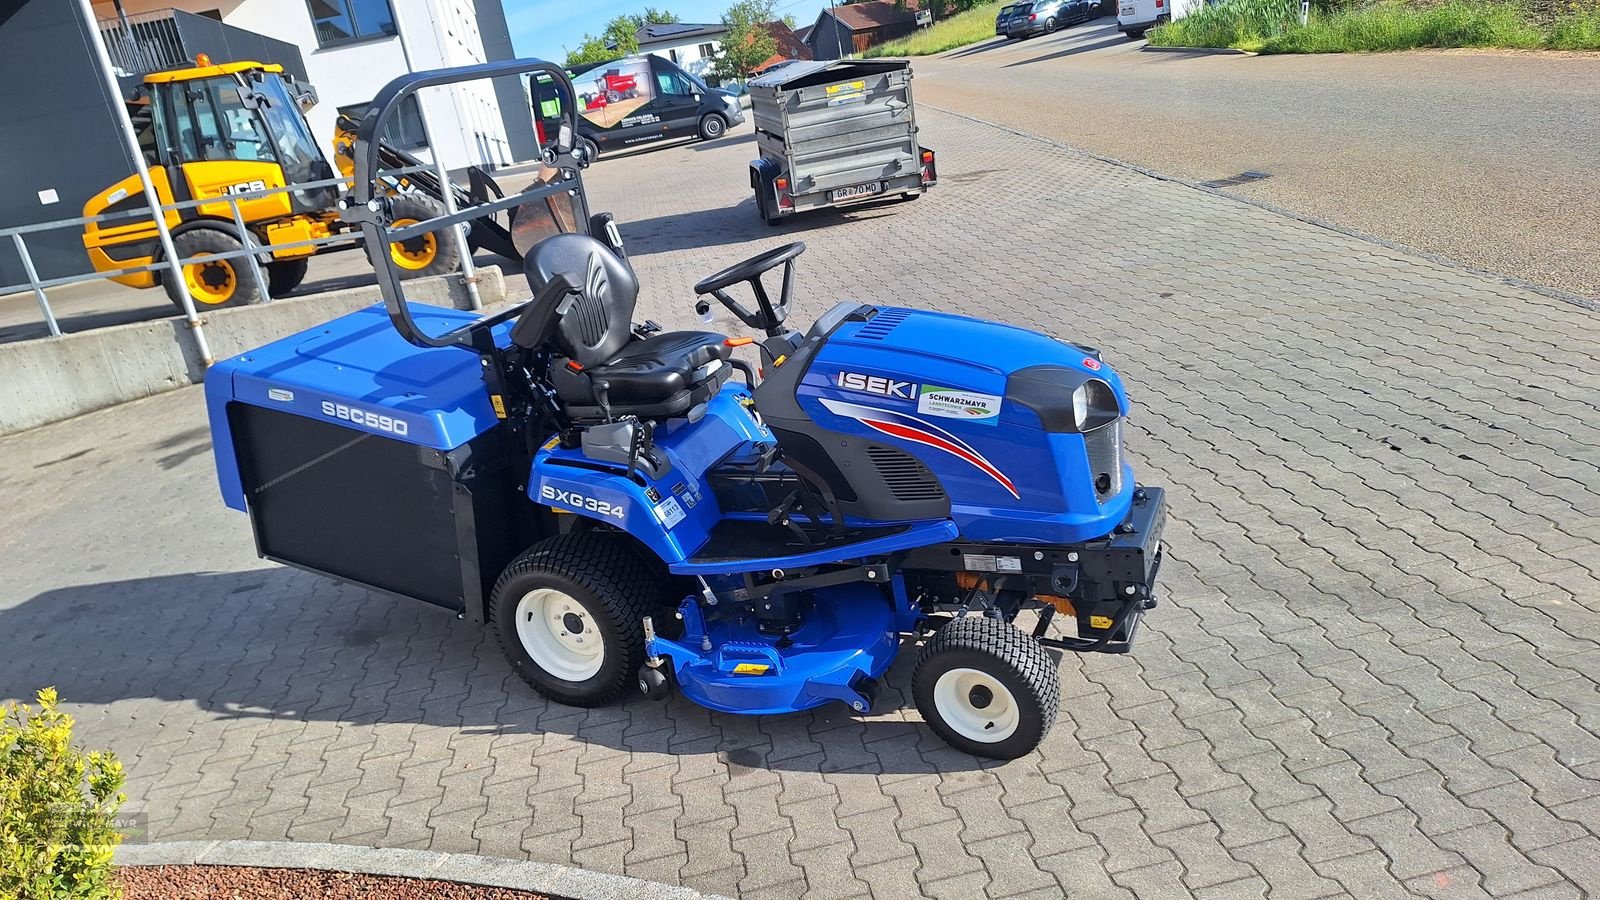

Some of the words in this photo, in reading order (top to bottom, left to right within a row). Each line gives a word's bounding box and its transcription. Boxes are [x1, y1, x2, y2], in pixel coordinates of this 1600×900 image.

[222, 180, 266, 197] JCB
[837, 189, 848, 198] GR
[854, 186, 864, 195] 70
[866, 183, 877, 193] MD
[838, 371, 917, 399] ISEKI
[929, 393, 987, 408] SCHWARZMAYR
[321, 401, 408, 436] SBC590
[542, 485, 624, 519] SXG324
